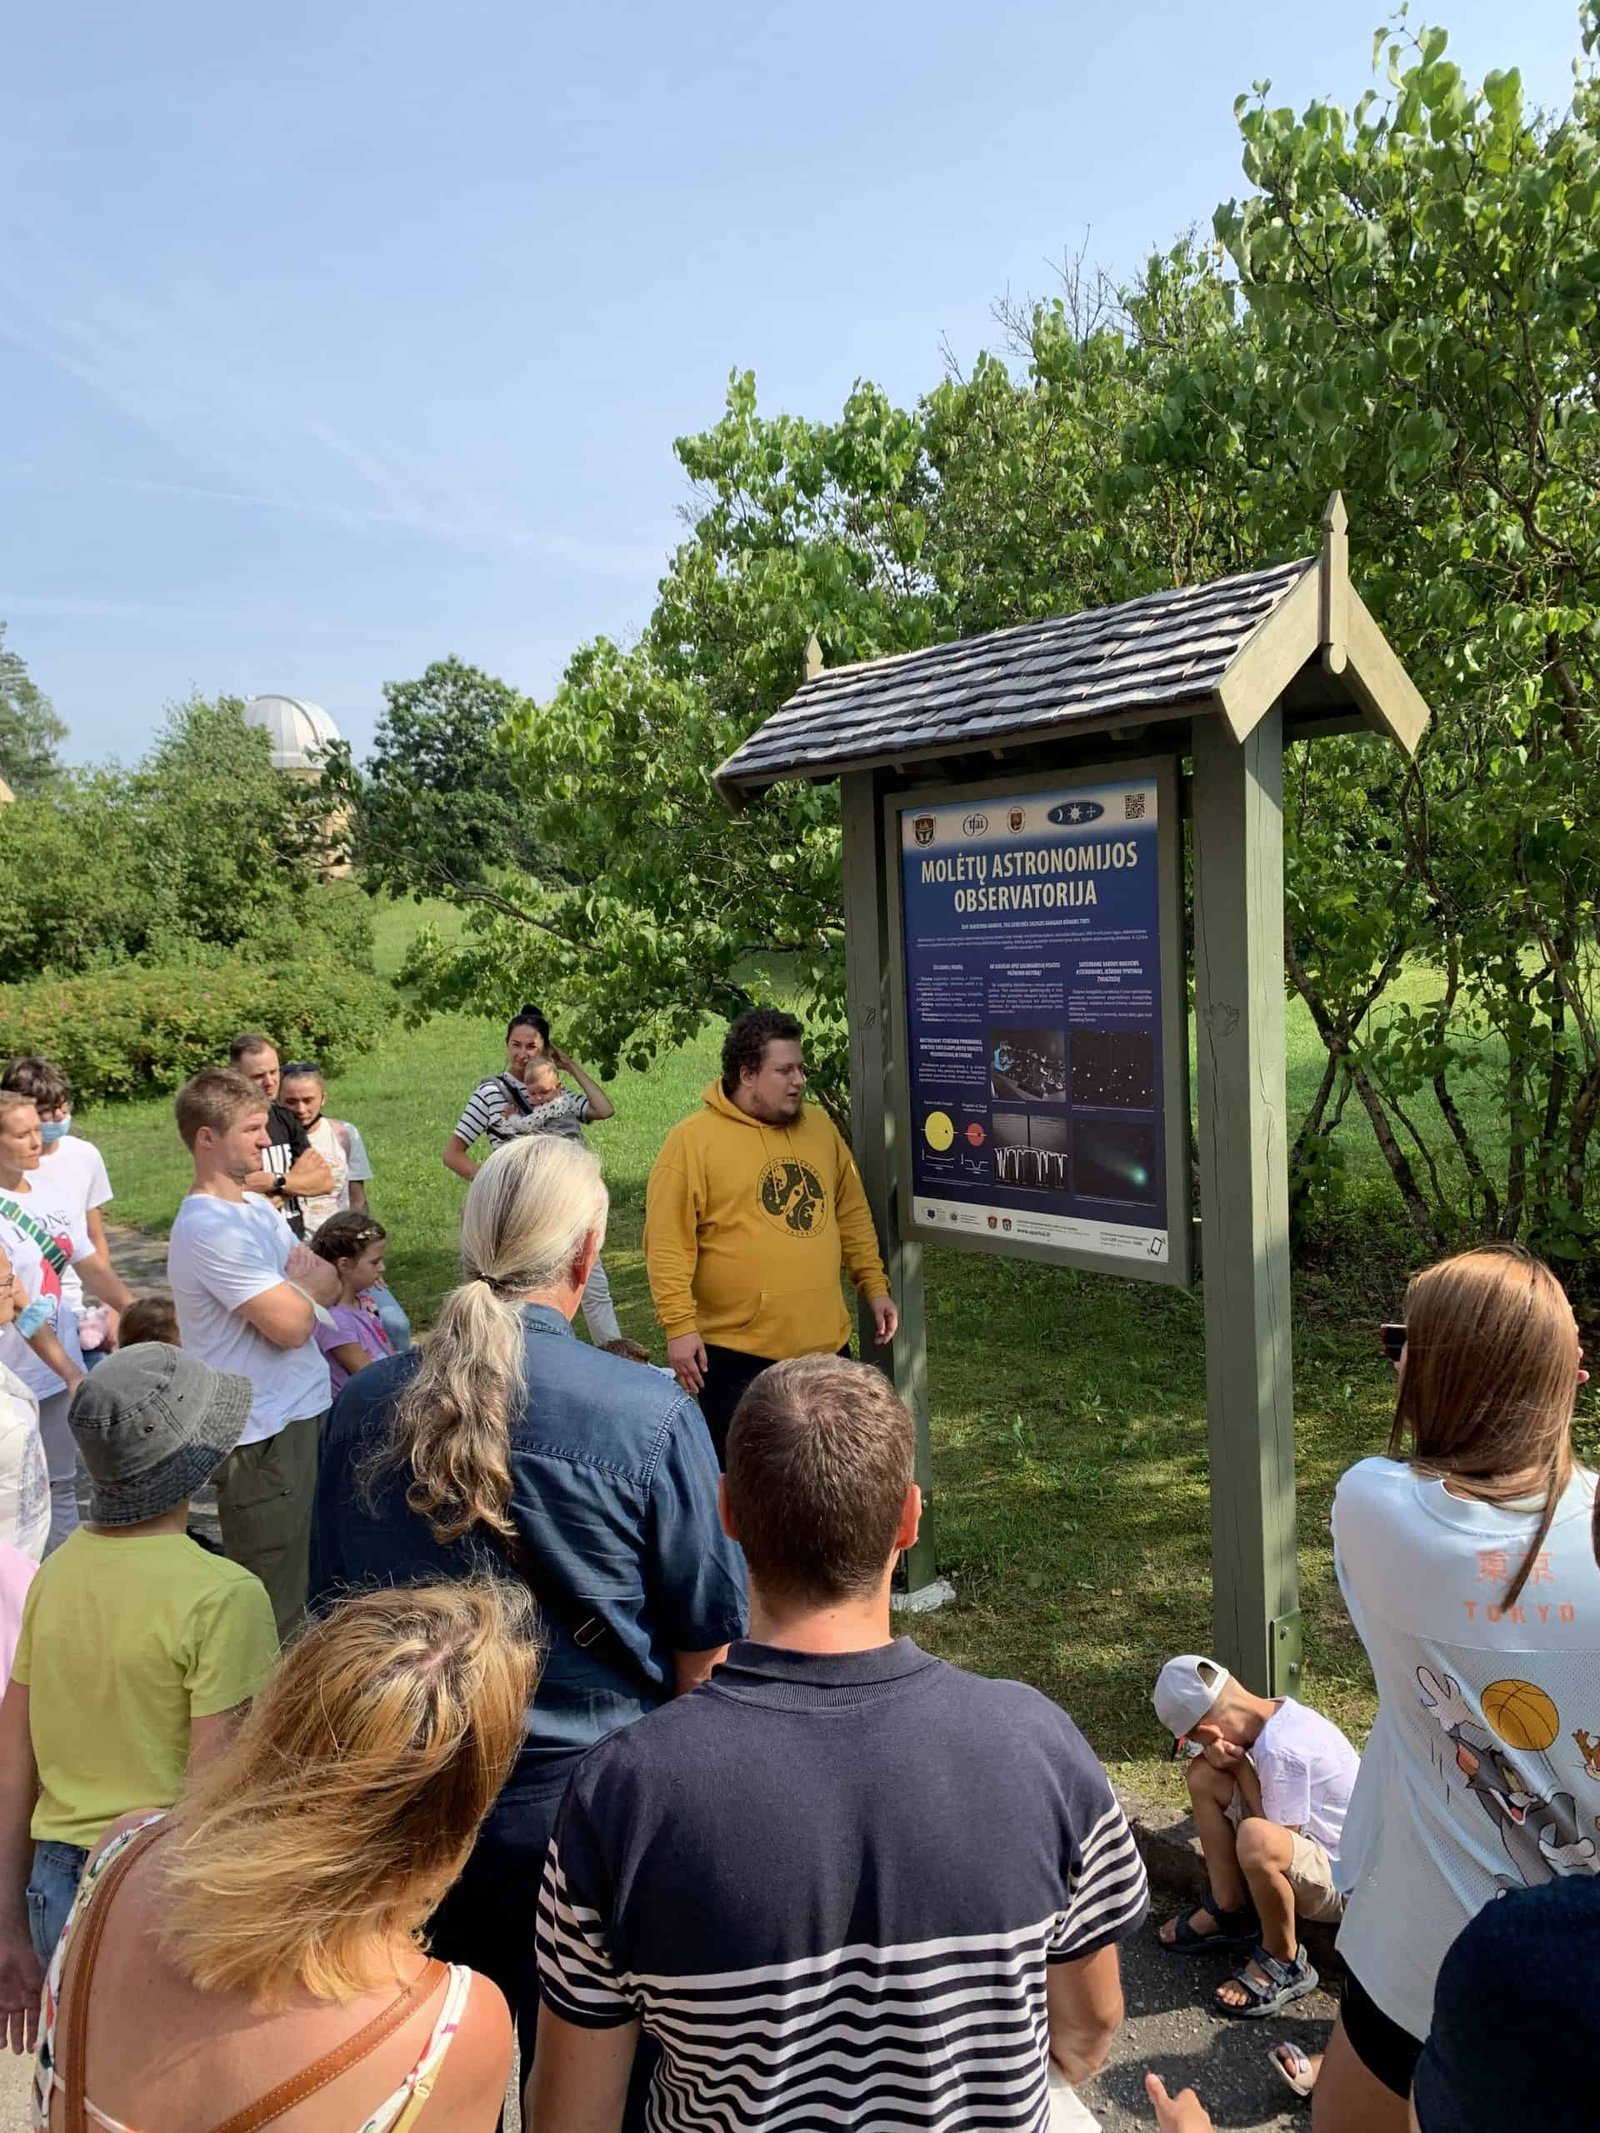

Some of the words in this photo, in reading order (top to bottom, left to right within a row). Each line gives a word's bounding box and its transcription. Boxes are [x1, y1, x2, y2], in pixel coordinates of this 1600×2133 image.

[921, 853, 988, 885] MOLĖTŲ
[992, 841, 1138, 879] ASTRONOMIJOS
[954, 880, 1097, 913] OBSERVATORIJA
[1462, 1600, 1575, 1624] TOKYO
